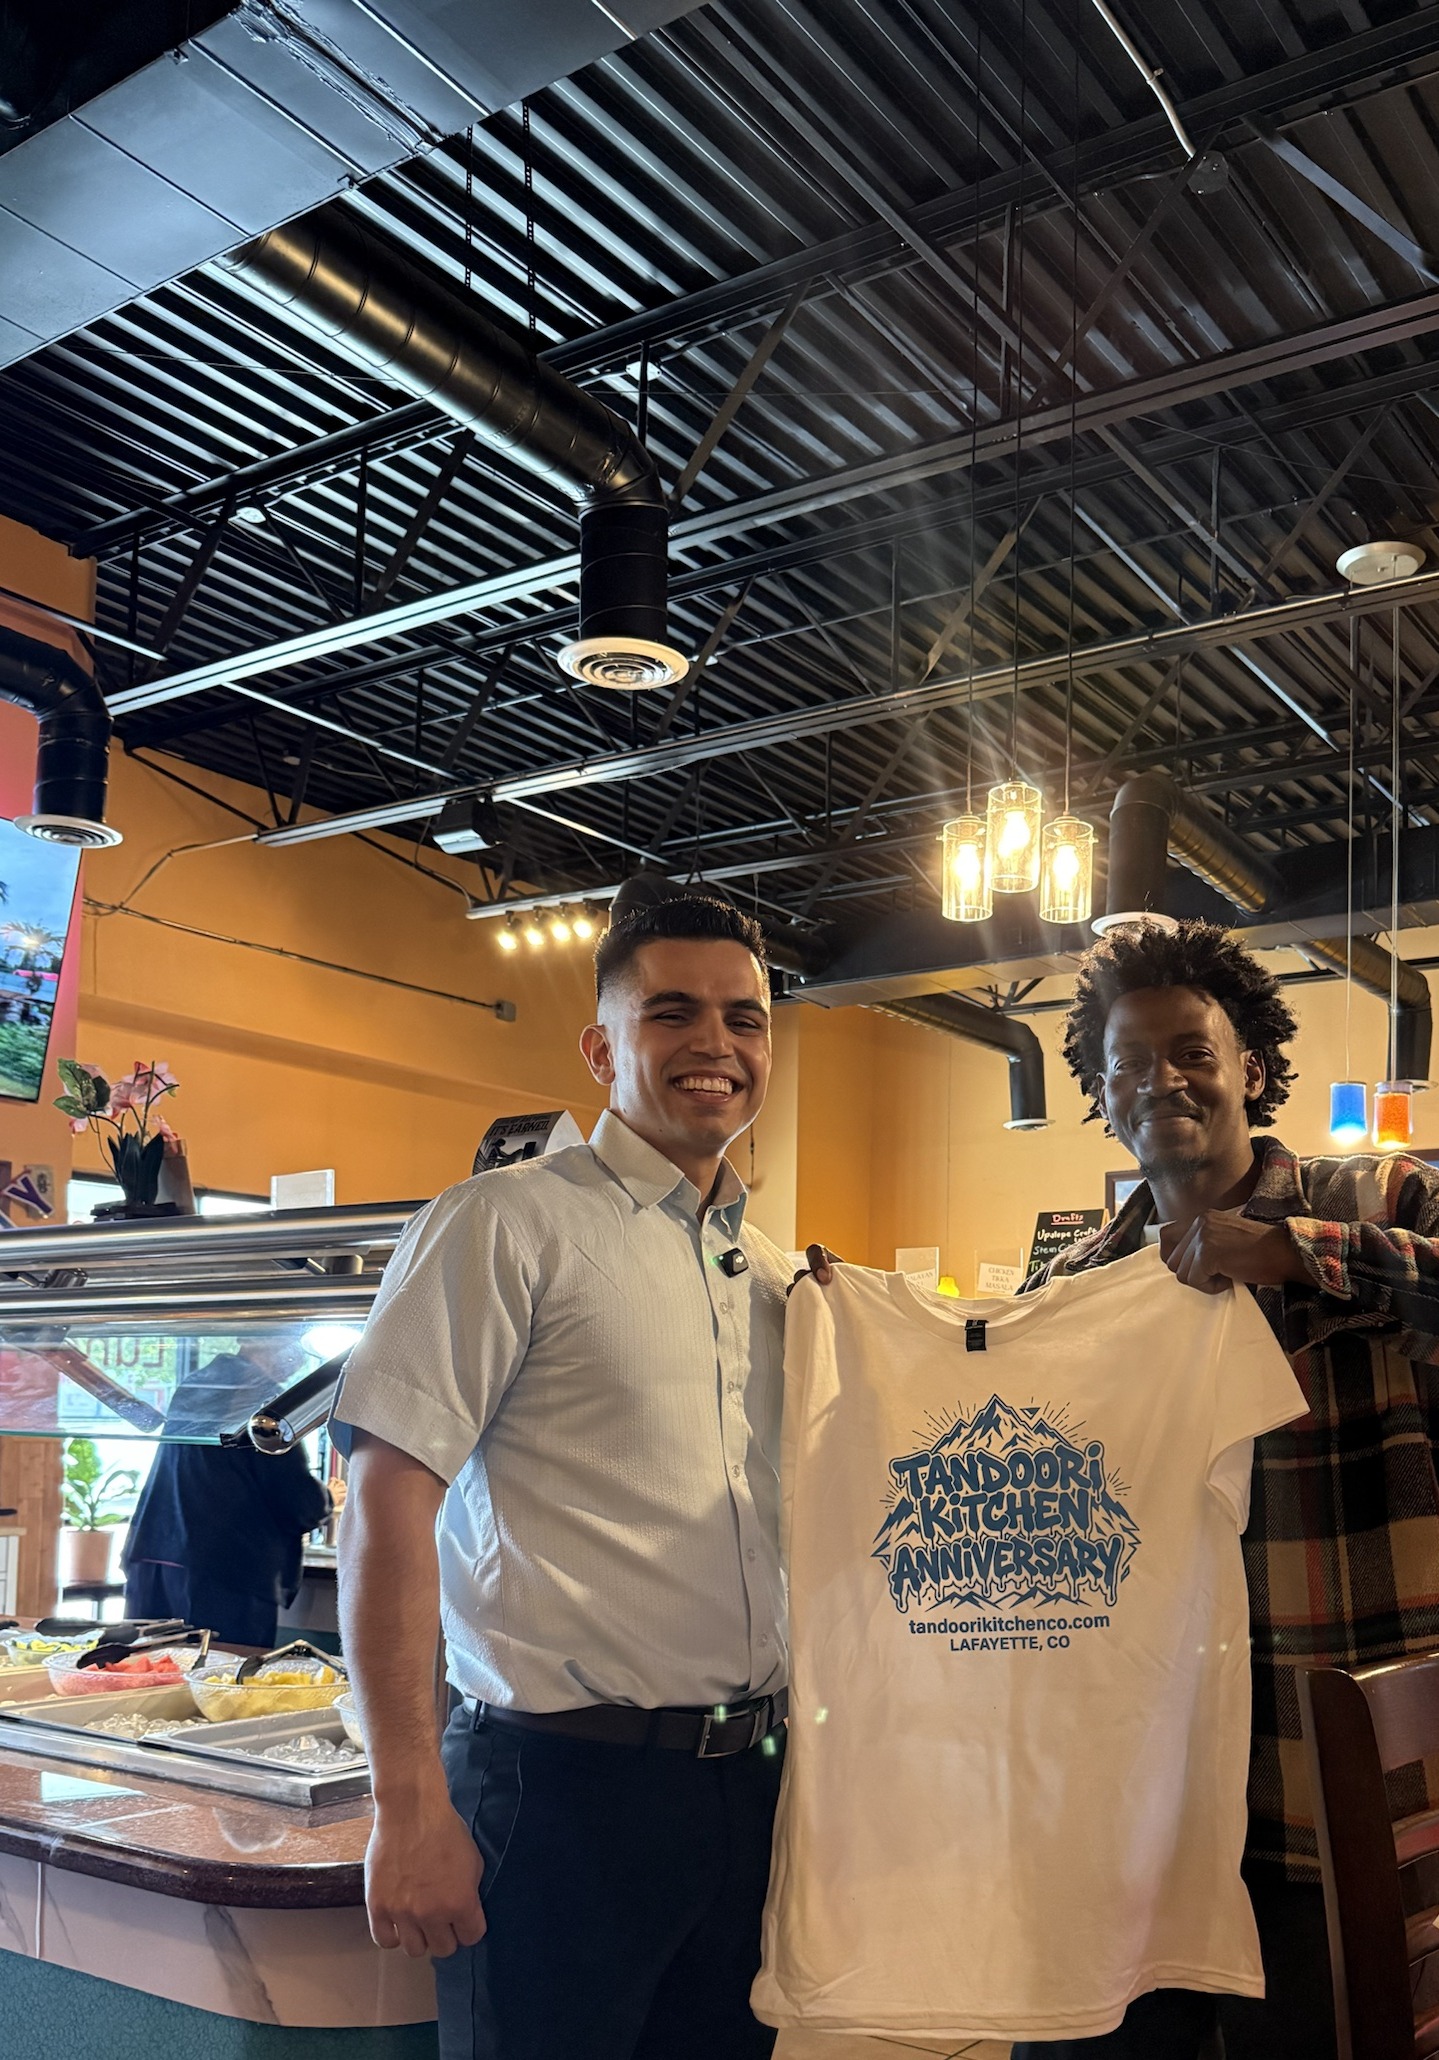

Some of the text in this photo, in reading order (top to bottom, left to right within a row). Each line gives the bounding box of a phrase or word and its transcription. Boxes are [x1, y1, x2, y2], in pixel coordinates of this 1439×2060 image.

[988, 1267, 1014, 1276] CHICKEN
[985, 1282, 1014, 1291] MASALA
[909, 1614, 1110, 1634] tandoorikitchenco.com
[950, 1635, 1070, 1651] LAFAYETTE, CO
